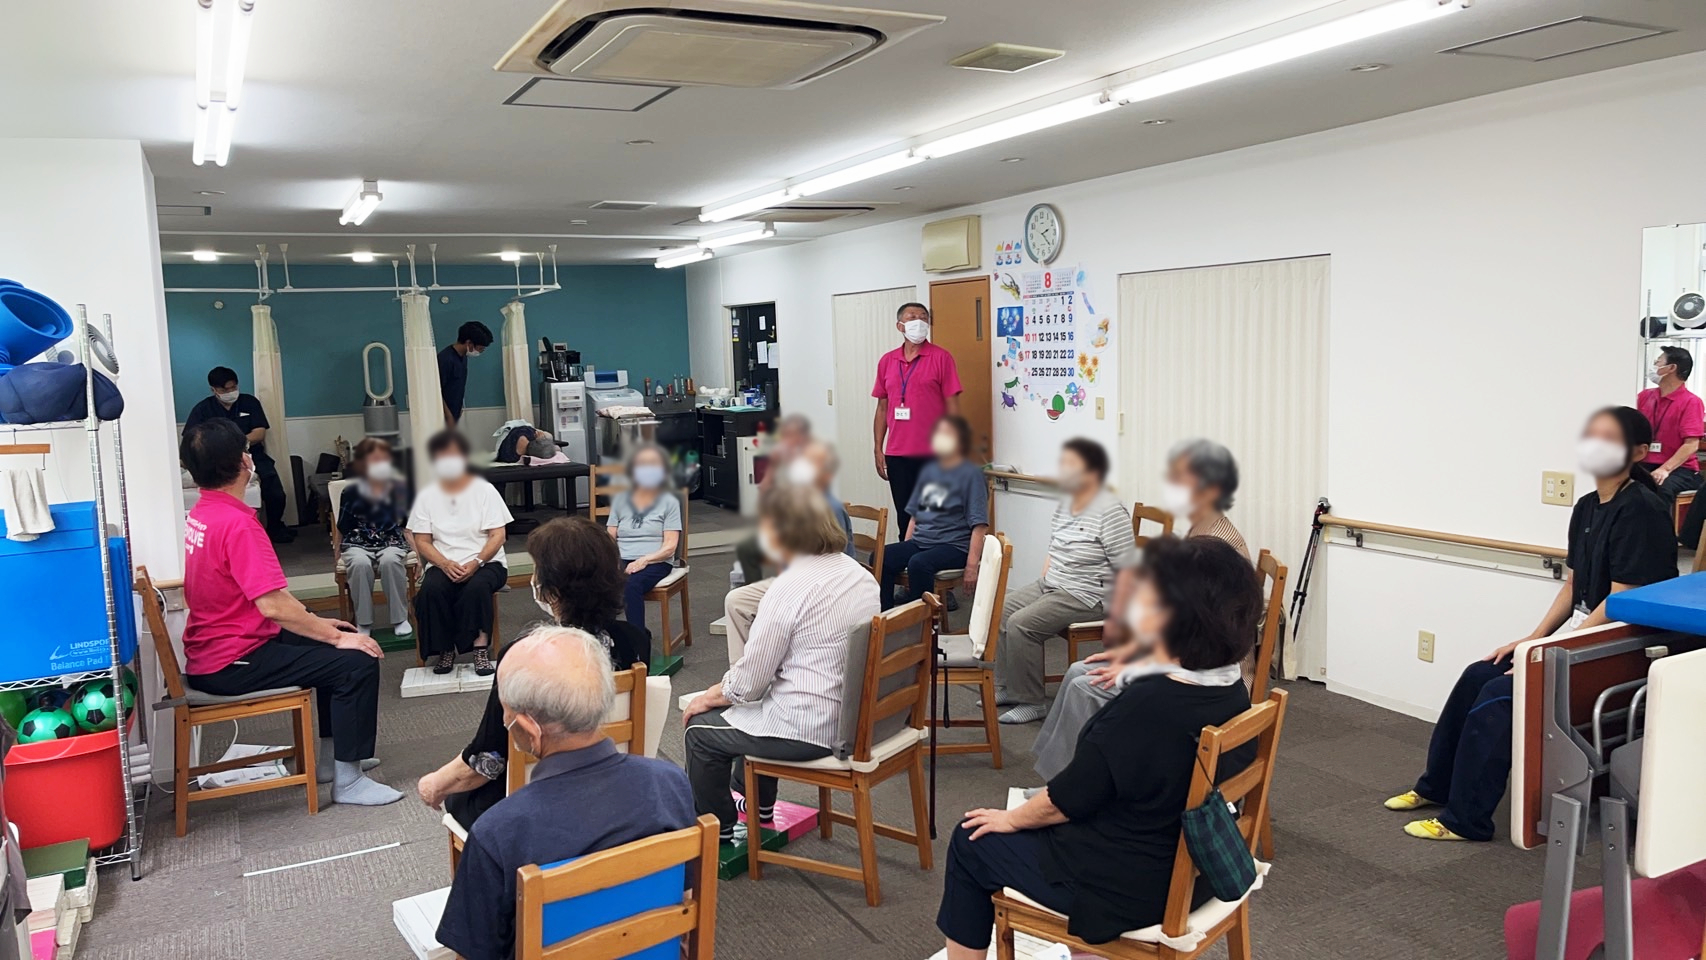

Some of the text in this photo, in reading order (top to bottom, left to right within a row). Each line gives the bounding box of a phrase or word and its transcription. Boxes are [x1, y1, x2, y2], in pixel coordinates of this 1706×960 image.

[1044, 272, 1051, 288] 8
[1068, 295, 1073, 304] 2
[1025, 313, 1073, 325] 3 4 5 6 7 8 9
[1025, 332, 1074, 342] 10 11 12 13 14 15 16
[1025, 350, 1074, 359] 17 18 19 20 21 22 23
[1032, 367, 1038, 376] 25
[1039, 367, 1044, 376] 26
[1046, 367, 1051, 376] 27
[1053, 367, 1059, 376] 28
[1060, 367, 1066, 376] 29
[1068, 367, 1074, 376] 30
[51, 660, 85, 670] Balance
[87, 656, 103, 666] Pad
